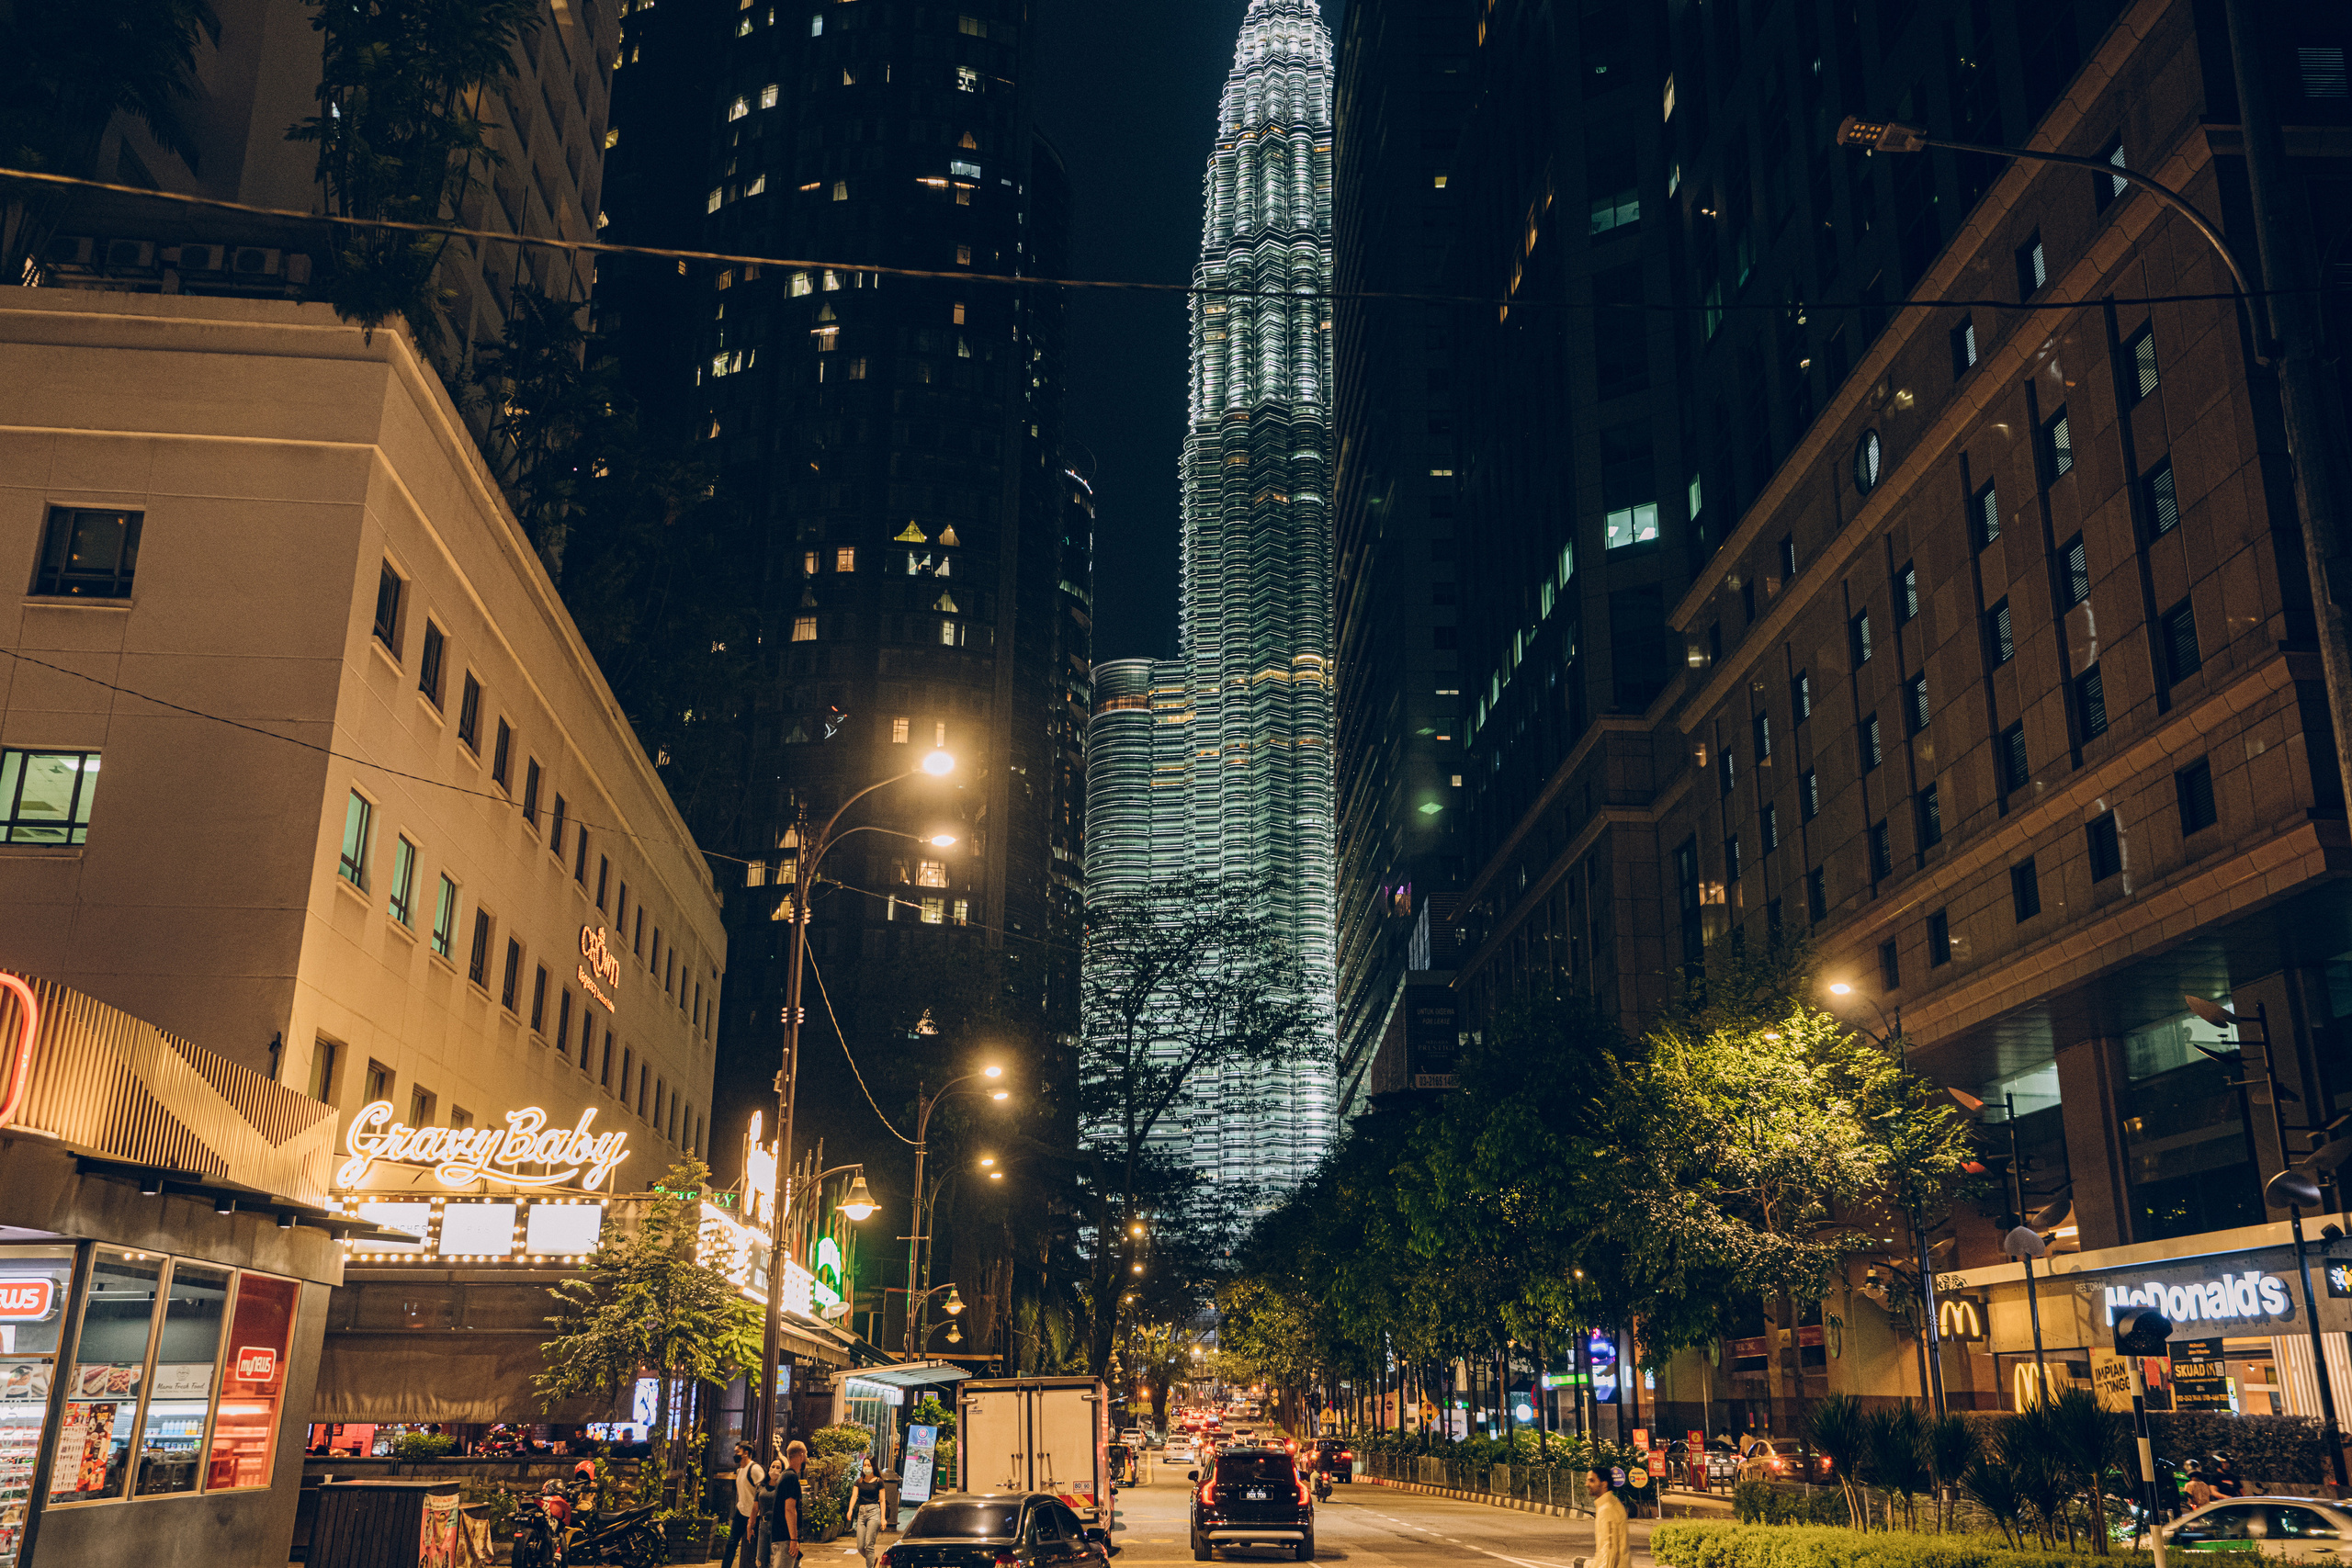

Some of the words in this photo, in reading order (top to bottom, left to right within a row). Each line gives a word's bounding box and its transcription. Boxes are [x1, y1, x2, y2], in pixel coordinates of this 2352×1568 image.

[336, 1100, 511, 1188] Gravy
[495, 1106, 630, 1190] Baby
[2075, 1280, 2107, 1293] RESTORAN
[2105, 1271, 2288, 1327] McDonald's
[2095, 1362, 2126, 1382] IMPIAN
[2174, 1363, 2206, 1378] SKUAD
[2104, 1376, 2131, 1393] TINGG
